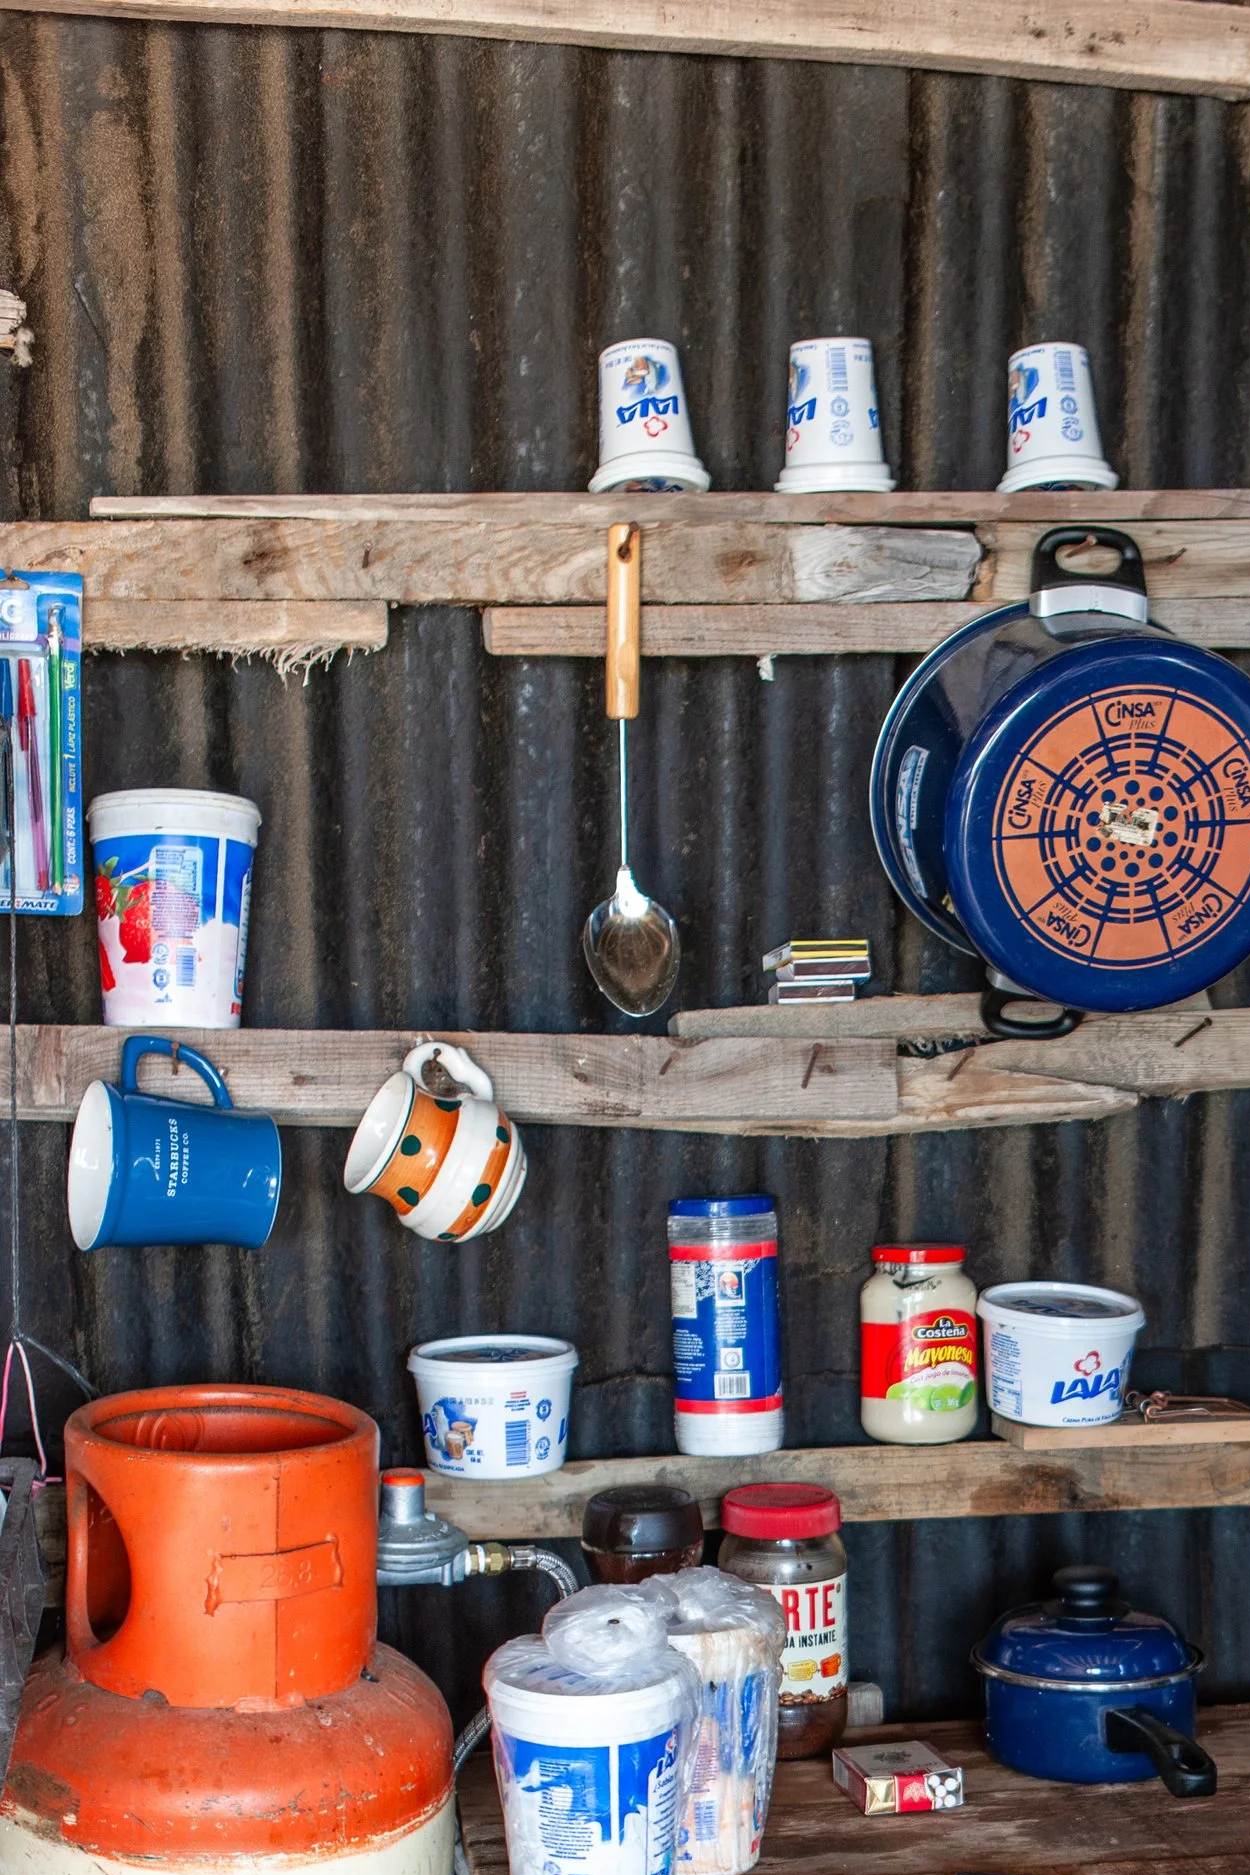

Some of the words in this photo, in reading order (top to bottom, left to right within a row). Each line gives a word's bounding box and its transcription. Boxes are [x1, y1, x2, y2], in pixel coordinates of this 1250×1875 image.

[615, 395, 679, 425] LALA
[166, 1118, 179, 1197] STARBUCKS
[181, 1147, 190, 1184] COFFEE
[917, 1325, 966, 1338] Costeña
[940, 1319, 951, 1328] La
[903, 1345, 973, 1372] Mayonesa
[1051, 1368, 1120, 1404] LALA
[798, 1629, 837, 1648] INSTANTE
